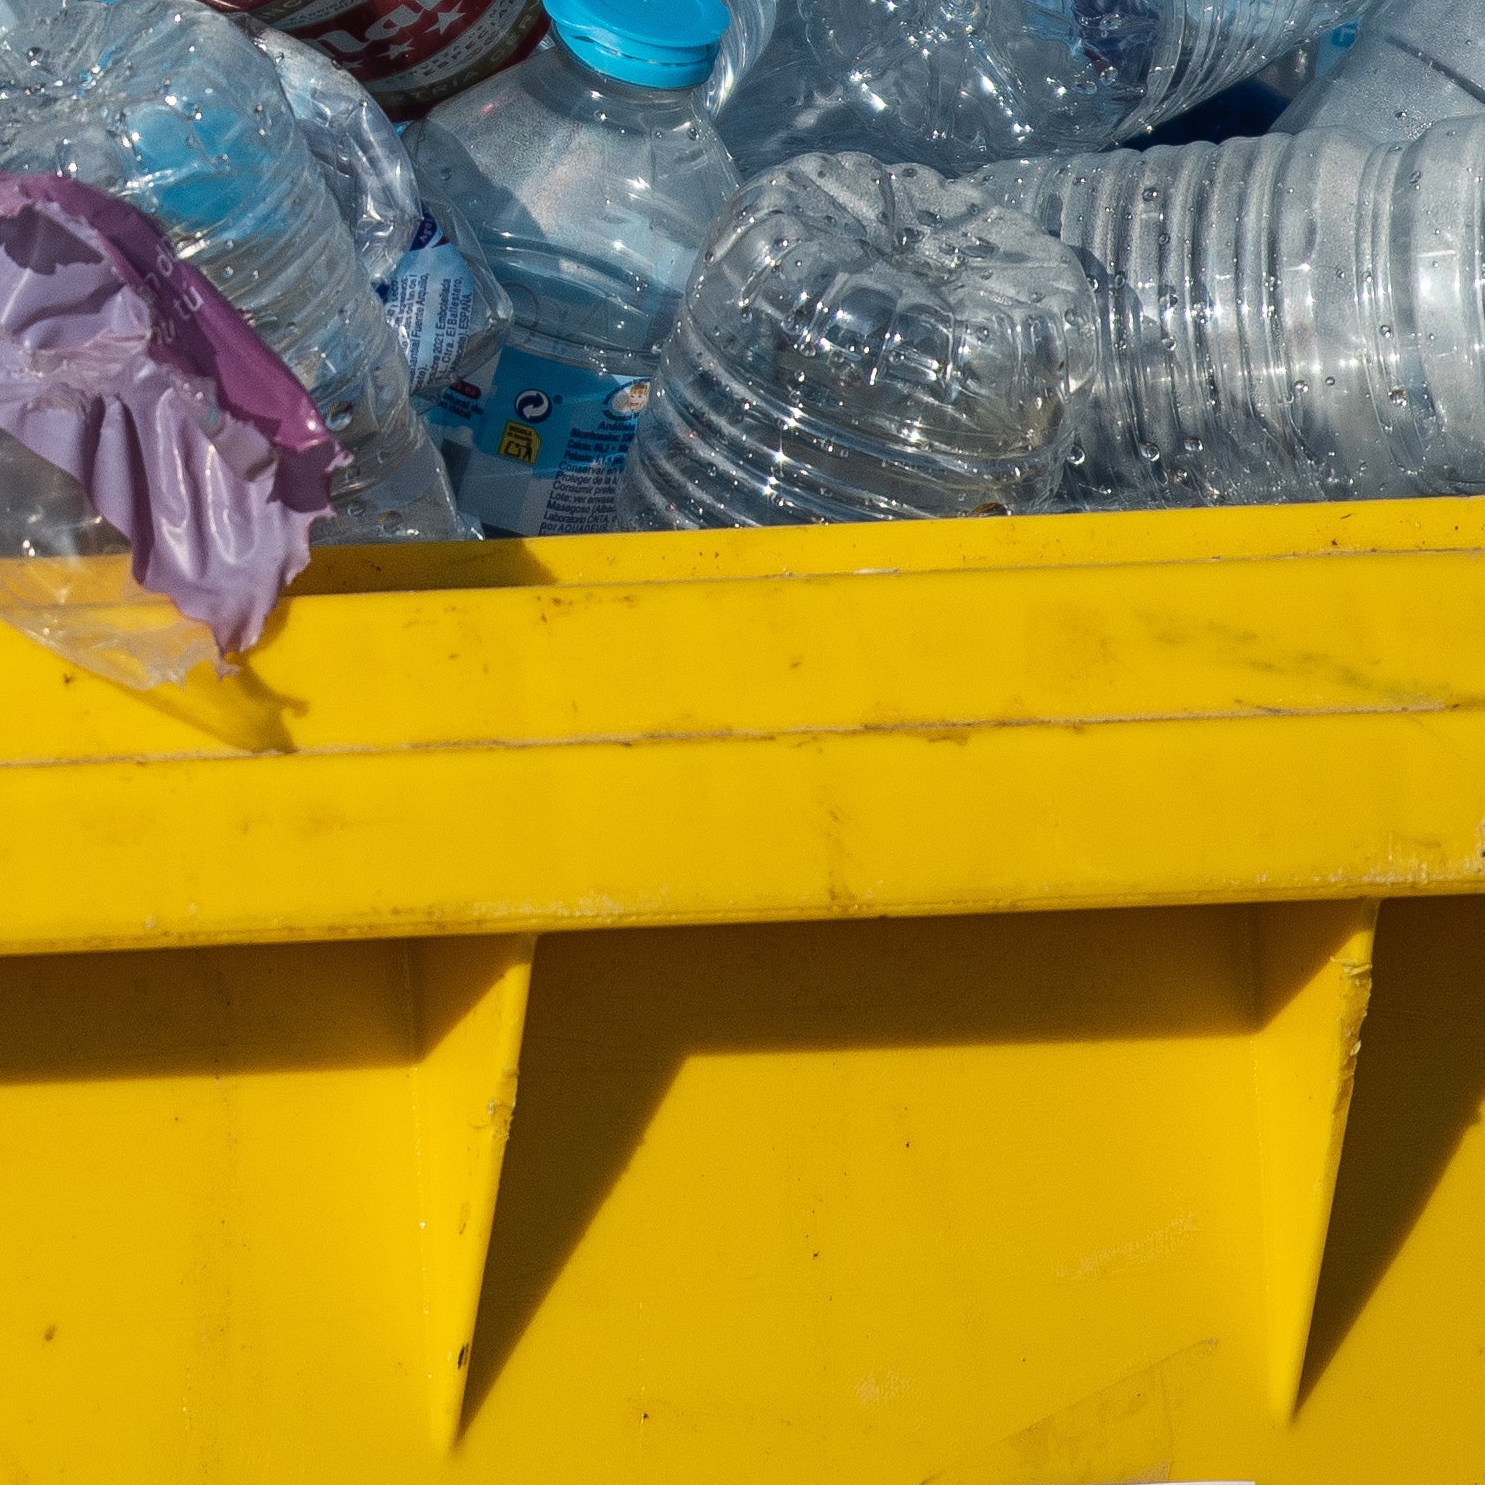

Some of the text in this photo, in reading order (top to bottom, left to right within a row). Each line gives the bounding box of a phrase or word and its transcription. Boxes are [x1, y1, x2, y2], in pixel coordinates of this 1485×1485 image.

[435, 277, 451, 330] Embotellada
[457, 292, 472, 330] ESPAÑA.
[411, 306, 424, 337] Fuente
[445, 326, 455, 337] El
[558, 460, 605, 476] Conservar
[554, 470, 592, 486] Proteger
[548, 489, 573, 502] Lote:
[552, 480, 592, 495] Consumir
